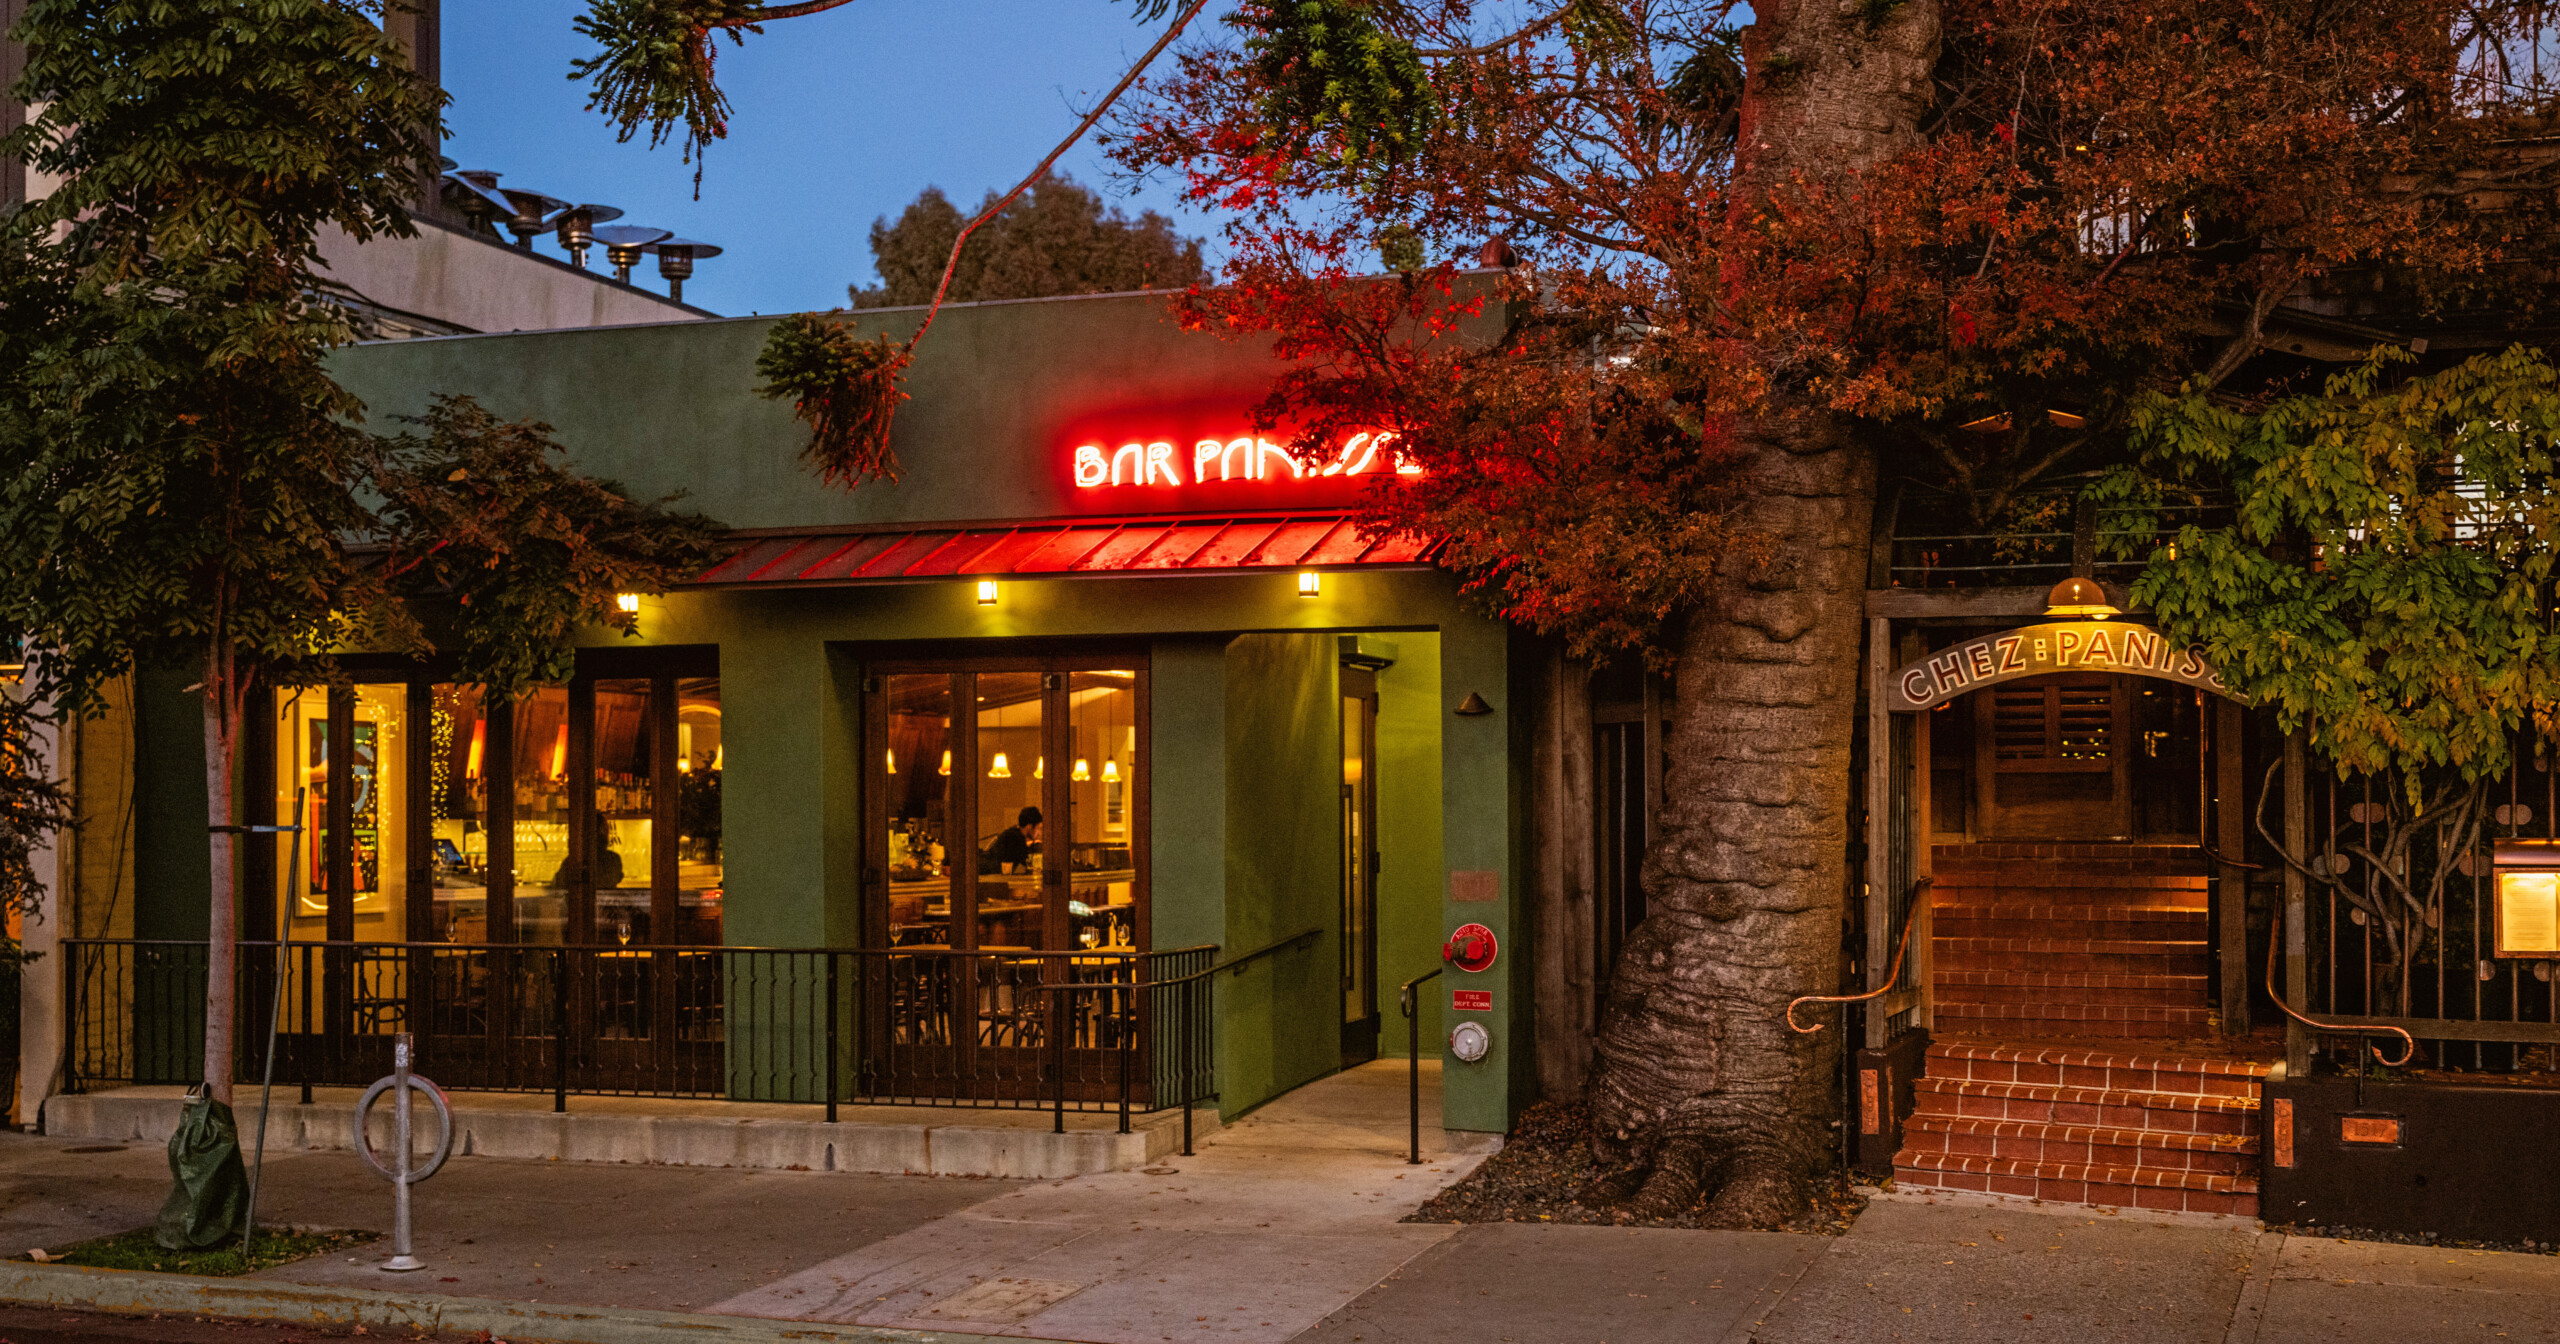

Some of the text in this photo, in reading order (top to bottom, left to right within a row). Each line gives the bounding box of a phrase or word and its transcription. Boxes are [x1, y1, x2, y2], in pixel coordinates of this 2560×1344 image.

[1074, 441, 1181, 487] BAR
[1902, 635, 2026, 704] CHEZ
[2056, 630, 2249, 699] PANIS
[2354, 1121, 2388, 1138] 1517
